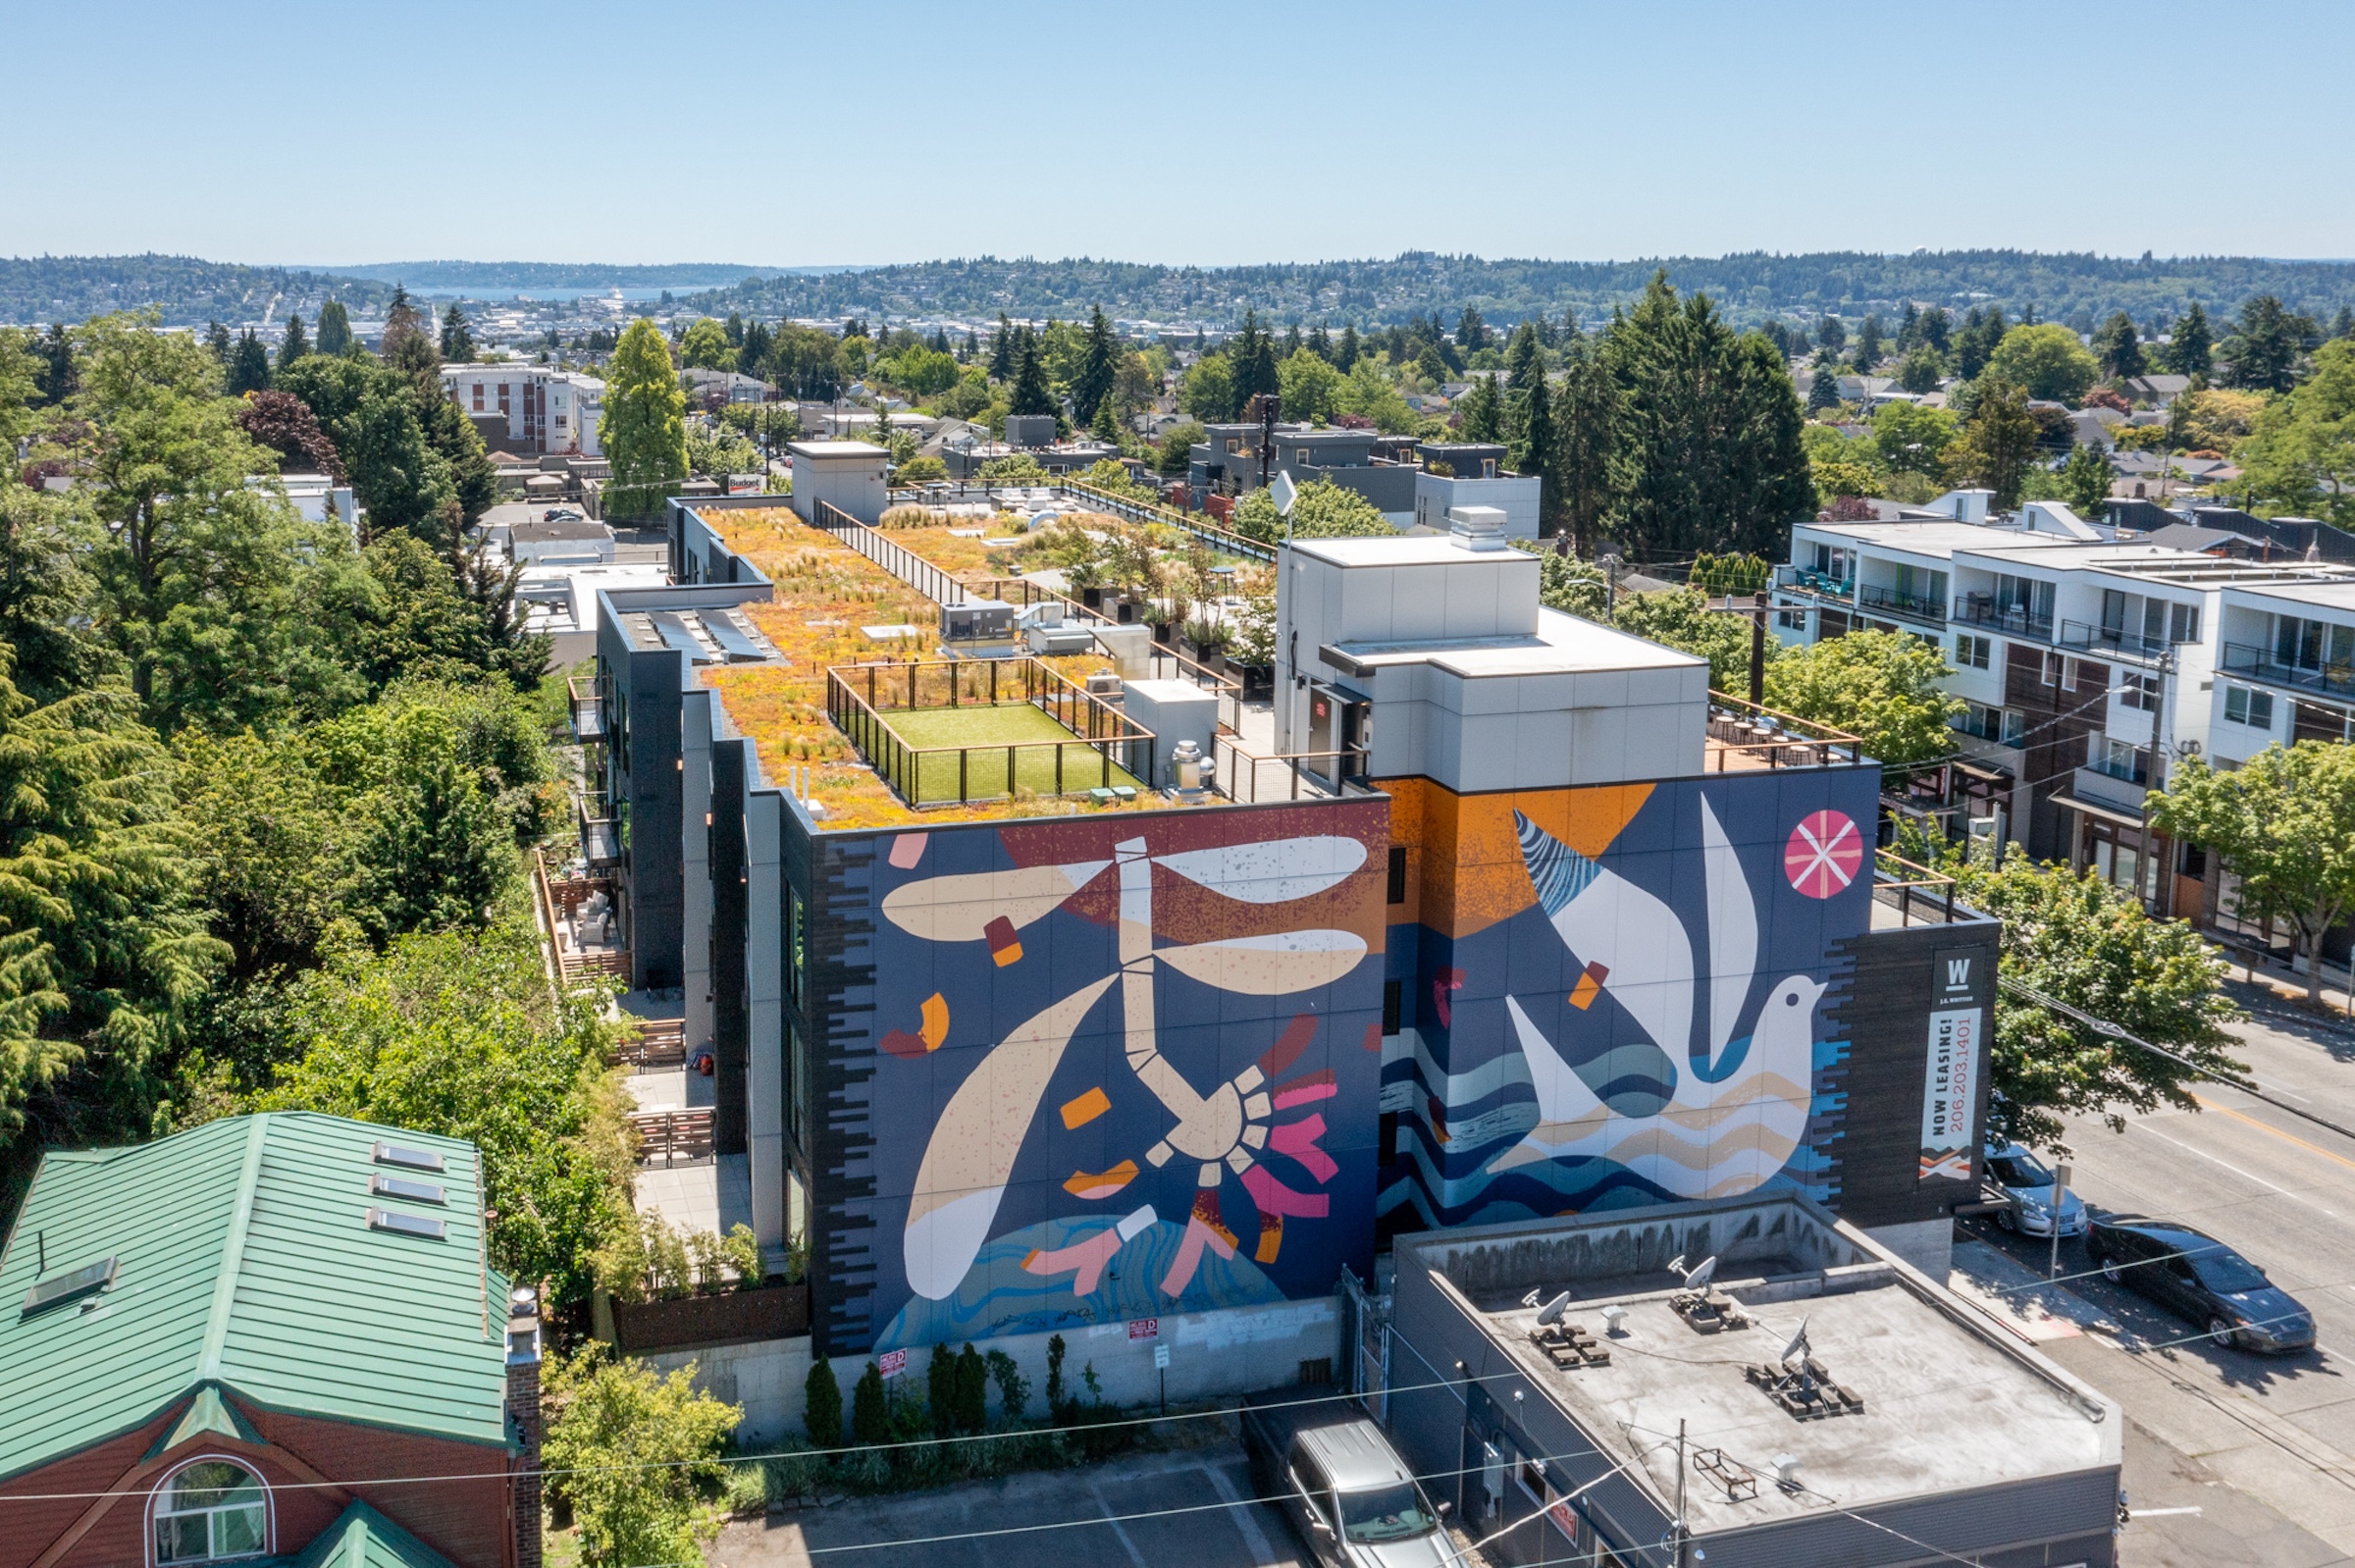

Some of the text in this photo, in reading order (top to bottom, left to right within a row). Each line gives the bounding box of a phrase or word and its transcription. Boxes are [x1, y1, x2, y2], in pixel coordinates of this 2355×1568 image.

[730, 479, 759, 488] Budget
[1948, 959, 1970, 984] W
[1933, 1019, 1952, 1135] NOW LEASING!
[1950, 1018, 1970, 1132] 206.203.1401
